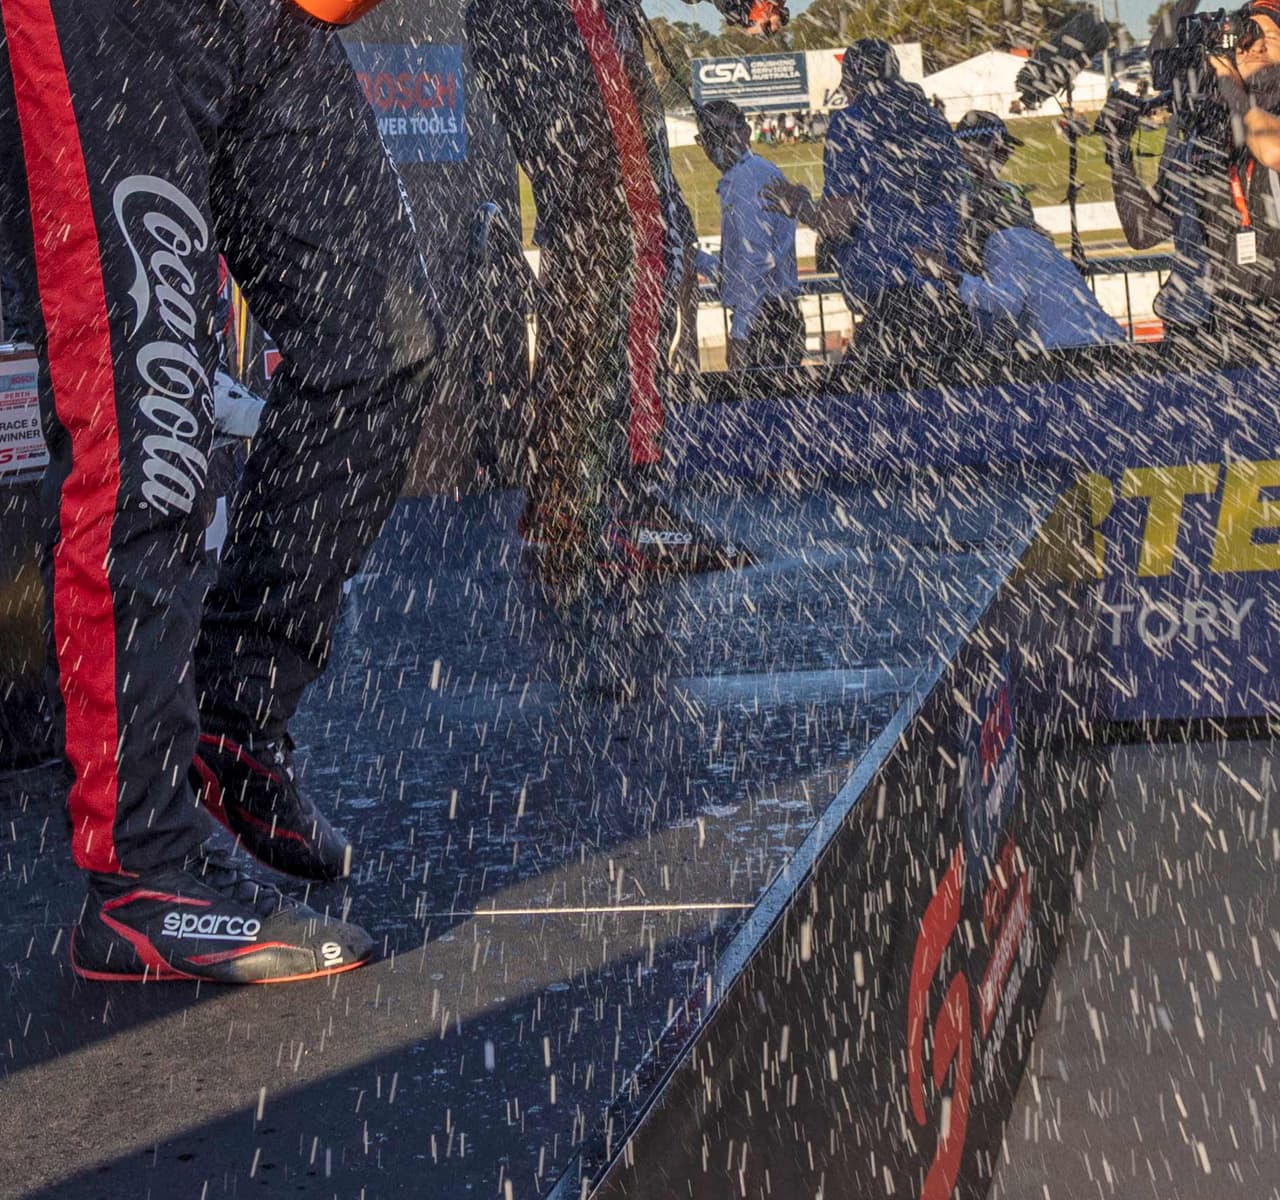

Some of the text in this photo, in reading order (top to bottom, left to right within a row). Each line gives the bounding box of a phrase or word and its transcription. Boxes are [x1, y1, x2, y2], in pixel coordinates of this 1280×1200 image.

[699, 63, 751, 84] CSA
[378, 117, 457, 135] WER TOOLS
[1102, 598, 1255, 646] TORY
[162, 912, 261, 941] sparco
